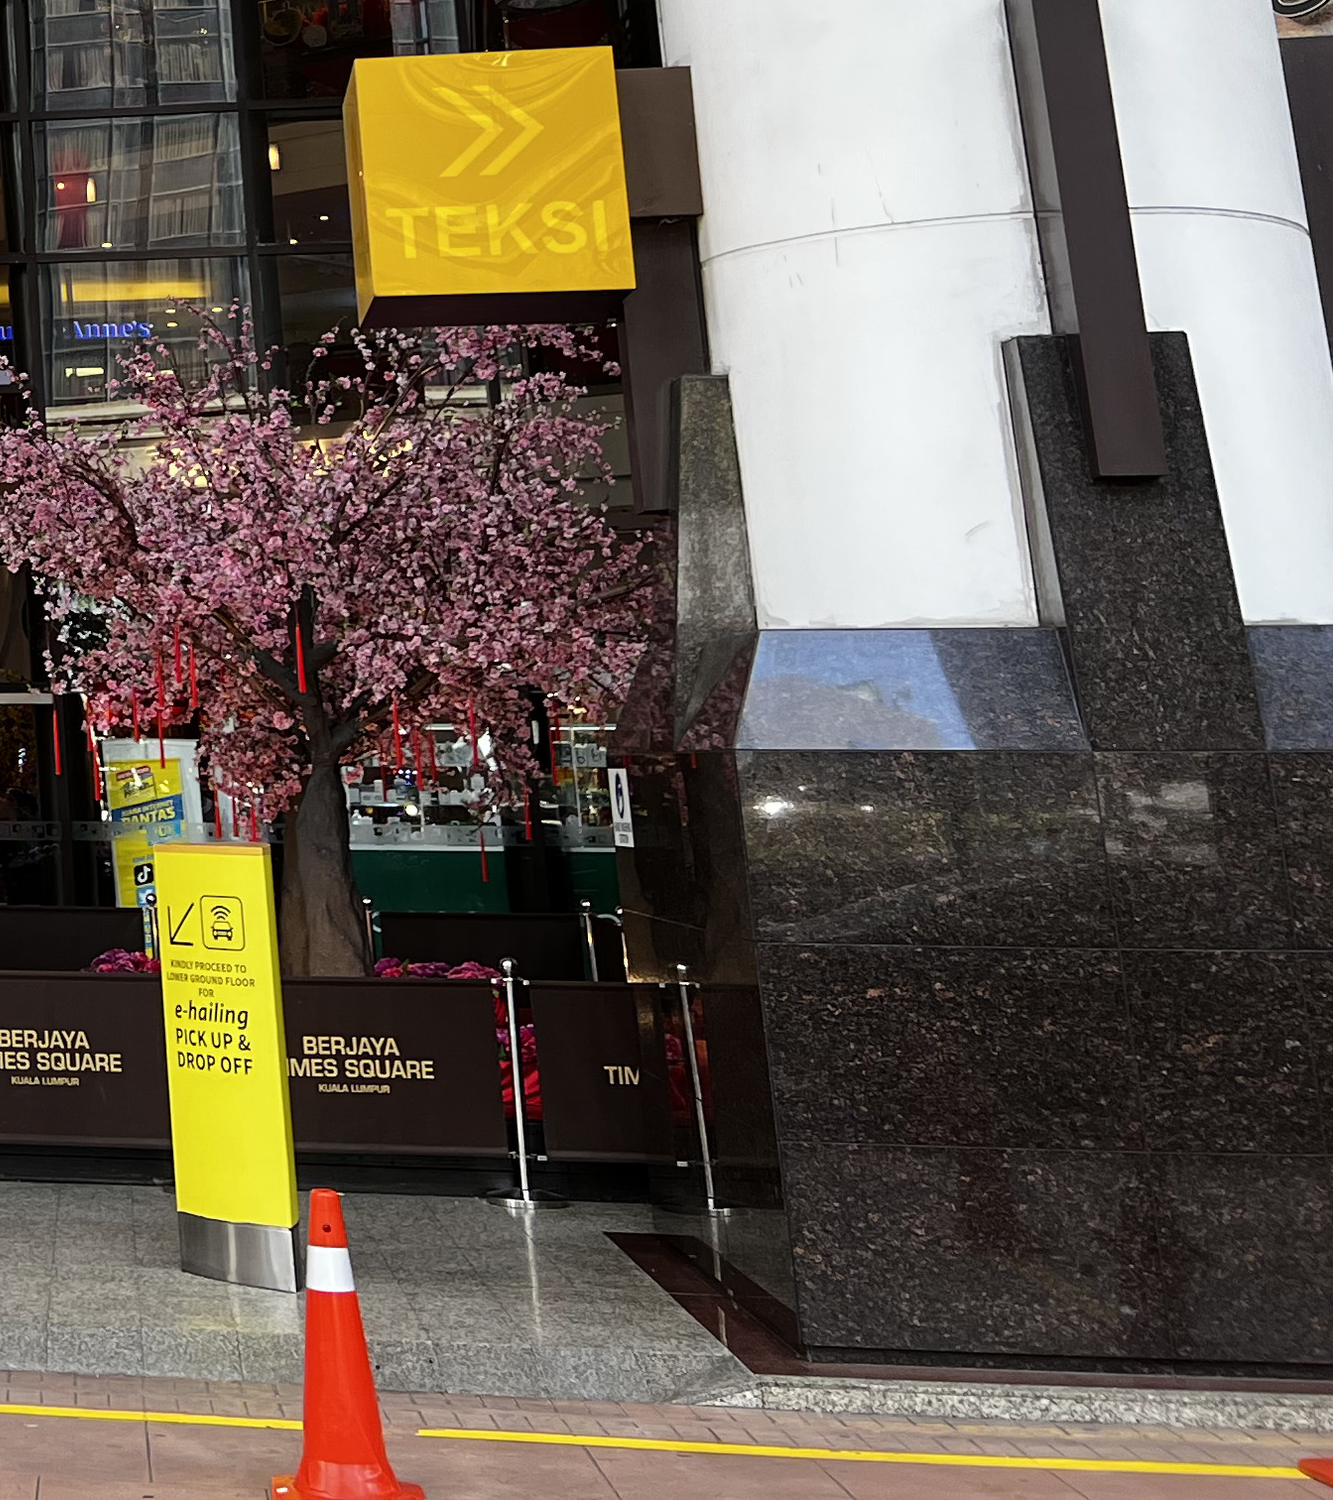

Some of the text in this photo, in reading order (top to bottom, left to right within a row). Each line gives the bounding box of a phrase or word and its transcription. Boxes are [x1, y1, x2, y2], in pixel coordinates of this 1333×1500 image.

[385, 199, 610, 261] TEKSI
[171, 959, 247, 973] KINDLY PROCEED TO
[166, 972, 255, 987] LOWER GROUND FLOOR
[199, 988, 214, 997] FOR
[175, 1000, 248, 1030] e-hailing
[176, 1028, 251, 1051] PICK UP &
[302, 1036, 401, 1056] BERJAYA
[36, 1052, 123, 1072] SQUARE
[177, 1051, 253, 1075] DROP OFF
[286, 1057, 435, 1079] IMES SQUARE
[11, 1076, 80, 1086] KUALA LUMPUR
[318, 1083, 390, 1094] KUALA LUMPUR
